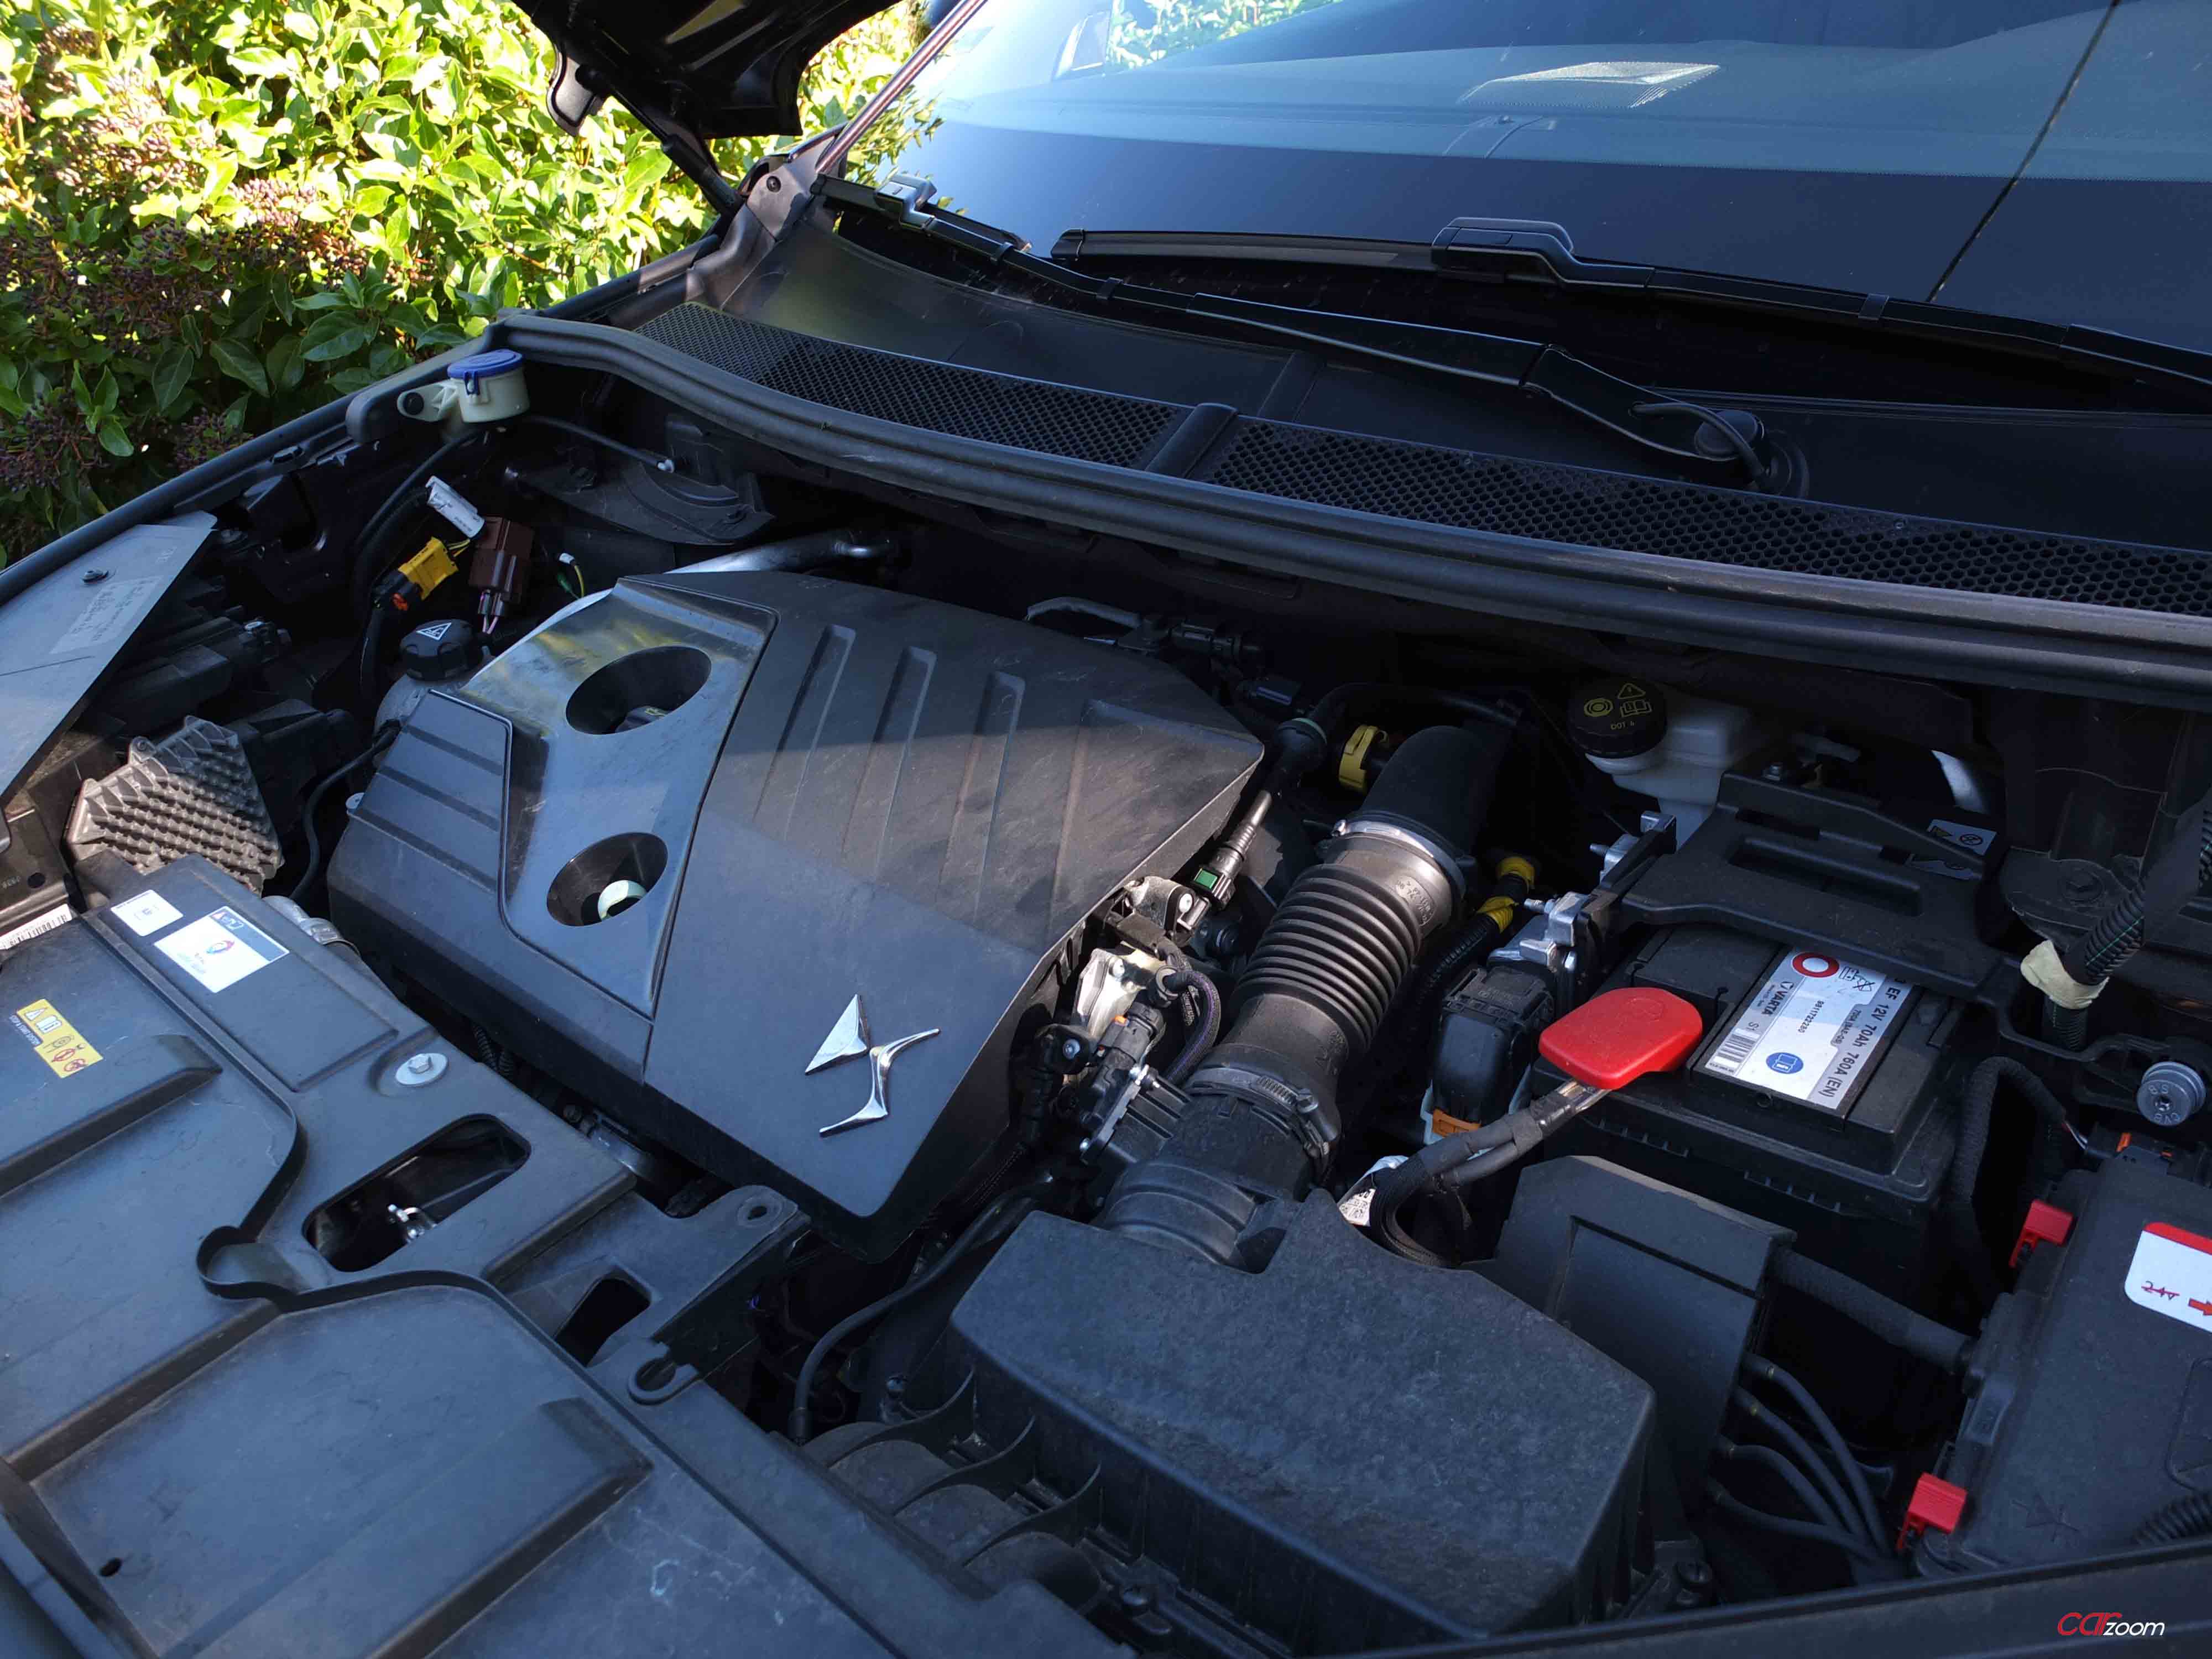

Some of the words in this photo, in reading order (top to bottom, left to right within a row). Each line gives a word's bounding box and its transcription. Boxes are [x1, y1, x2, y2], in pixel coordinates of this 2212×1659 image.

[1761, 991, 1787, 1015] VARTA
[1886, 987, 1901, 1000] EF
[1871, 1004, 1889, 1021] 12V
[1853, 1024, 1877, 1047] 70Ah
[1834, 1052, 1859, 1076] 760A
[1818, 1076, 1843, 1097] (EN)
